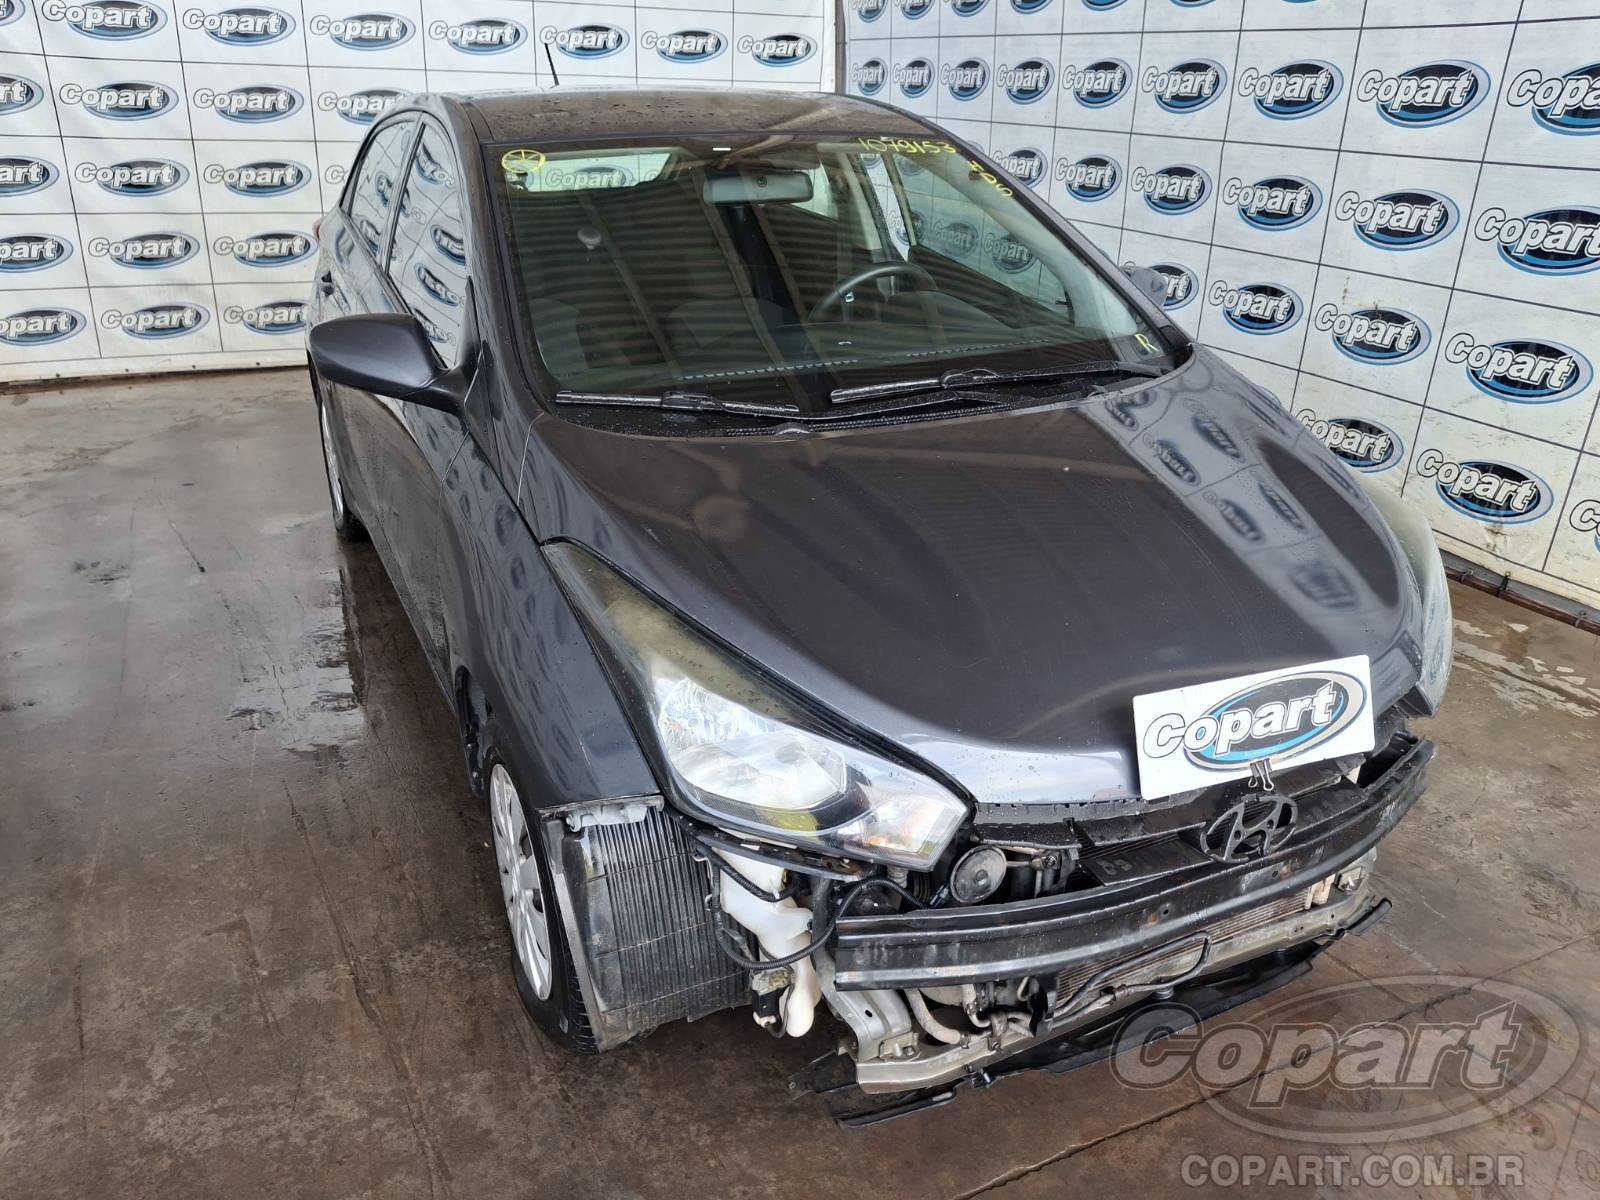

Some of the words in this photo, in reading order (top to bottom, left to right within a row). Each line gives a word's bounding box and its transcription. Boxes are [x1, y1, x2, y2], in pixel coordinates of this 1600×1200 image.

[42, 0, 151, 30] Copart
[182, 9, 283, 37] Copart
[310, 15, 403, 41] Copart
[428, 20, 518, 47] Copart
[540, 26, 622, 52] Copart
[641, 30, 720, 56] Copart
[737, 36, 808, 61] Copart
[851, 63, 883, 87] Copart
[893, 63, 930, 89] Copart
[940, 64, 985, 91] Copart
[997, 64, 1047, 94] Copart
[1062, 65, 1125, 98] Copart
[1141, 65, 1219, 101] Copart
[1238, 67, 1331, 106] Copart
[59, 83, 165, 110] Copart
[193, 88, 290, 113] Copart
[1356, 69, 1475, 113] Copart
[1507, 69, 1600, 118] Copa
[858, 137, 957, 154] 1079153
[75, 162, 177, 187] Copart
[203, 164, 302, 187] Copart
[1055, 157, 1115, 190] Copart
[1131, 166, 1201, 201] Copart
[1223, 177, 1313, 216] Copart
[1335, 191, 1444, 235] Copart
[88, 237, 190, 261] Copart
[213, 234, 308, 258] Copart
[983, 232, 1030, 260] Copart
[1209, 280, 1291, 323] Copart
[0, 312, 72, 339] opart
[101, 305, 200, 331] Copart
[1315, 303, 1419, 351] Copart
[1445, 333, 1575, 389] Copart
[1416, 449, 1535, 512] Copart
[1143, 680, 1337, 758] Copart
